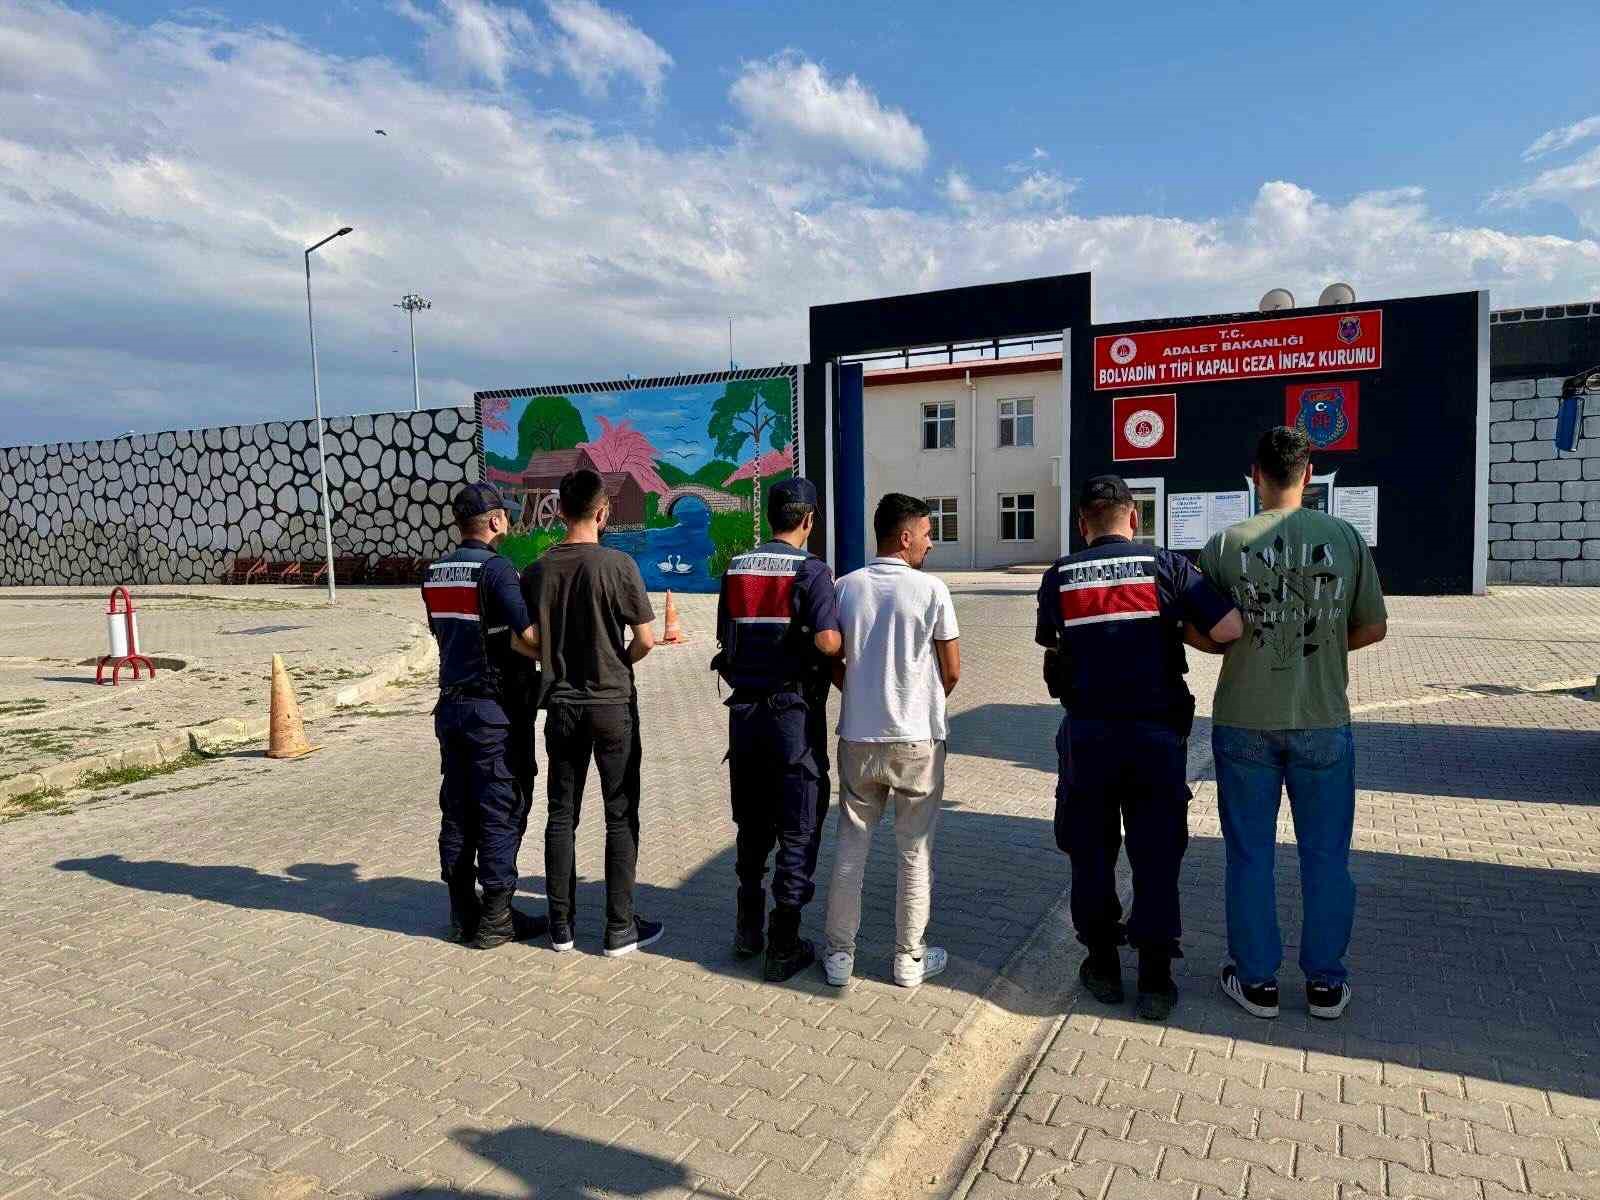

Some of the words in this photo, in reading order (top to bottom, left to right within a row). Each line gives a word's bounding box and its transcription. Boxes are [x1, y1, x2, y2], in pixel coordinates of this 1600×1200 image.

[1219, 329, 1244, 339] T.C.
[1162, 343, 1217, 356] ADALET
[1222, 335, 1304, 351] BAKANLIĞI
[1099, 363, 1156, 384] BOLVADİN
[1159, 363, 1167, 379] T
[1170, 358, 1193, 377] TİPİ
[1196, 357, 1239, 376] KAPALI
[1242, 354, 1275, 372] CEZA
[1279, 351, 1316, 369] İNFAZ
[1319, 347, 1376, 366] KURUMU
[736, 557, 794, 571] JANDARMA
[1068, 561, 1144, 583] JANDARMA
[430, 567, 472, 583] JANDARMA
